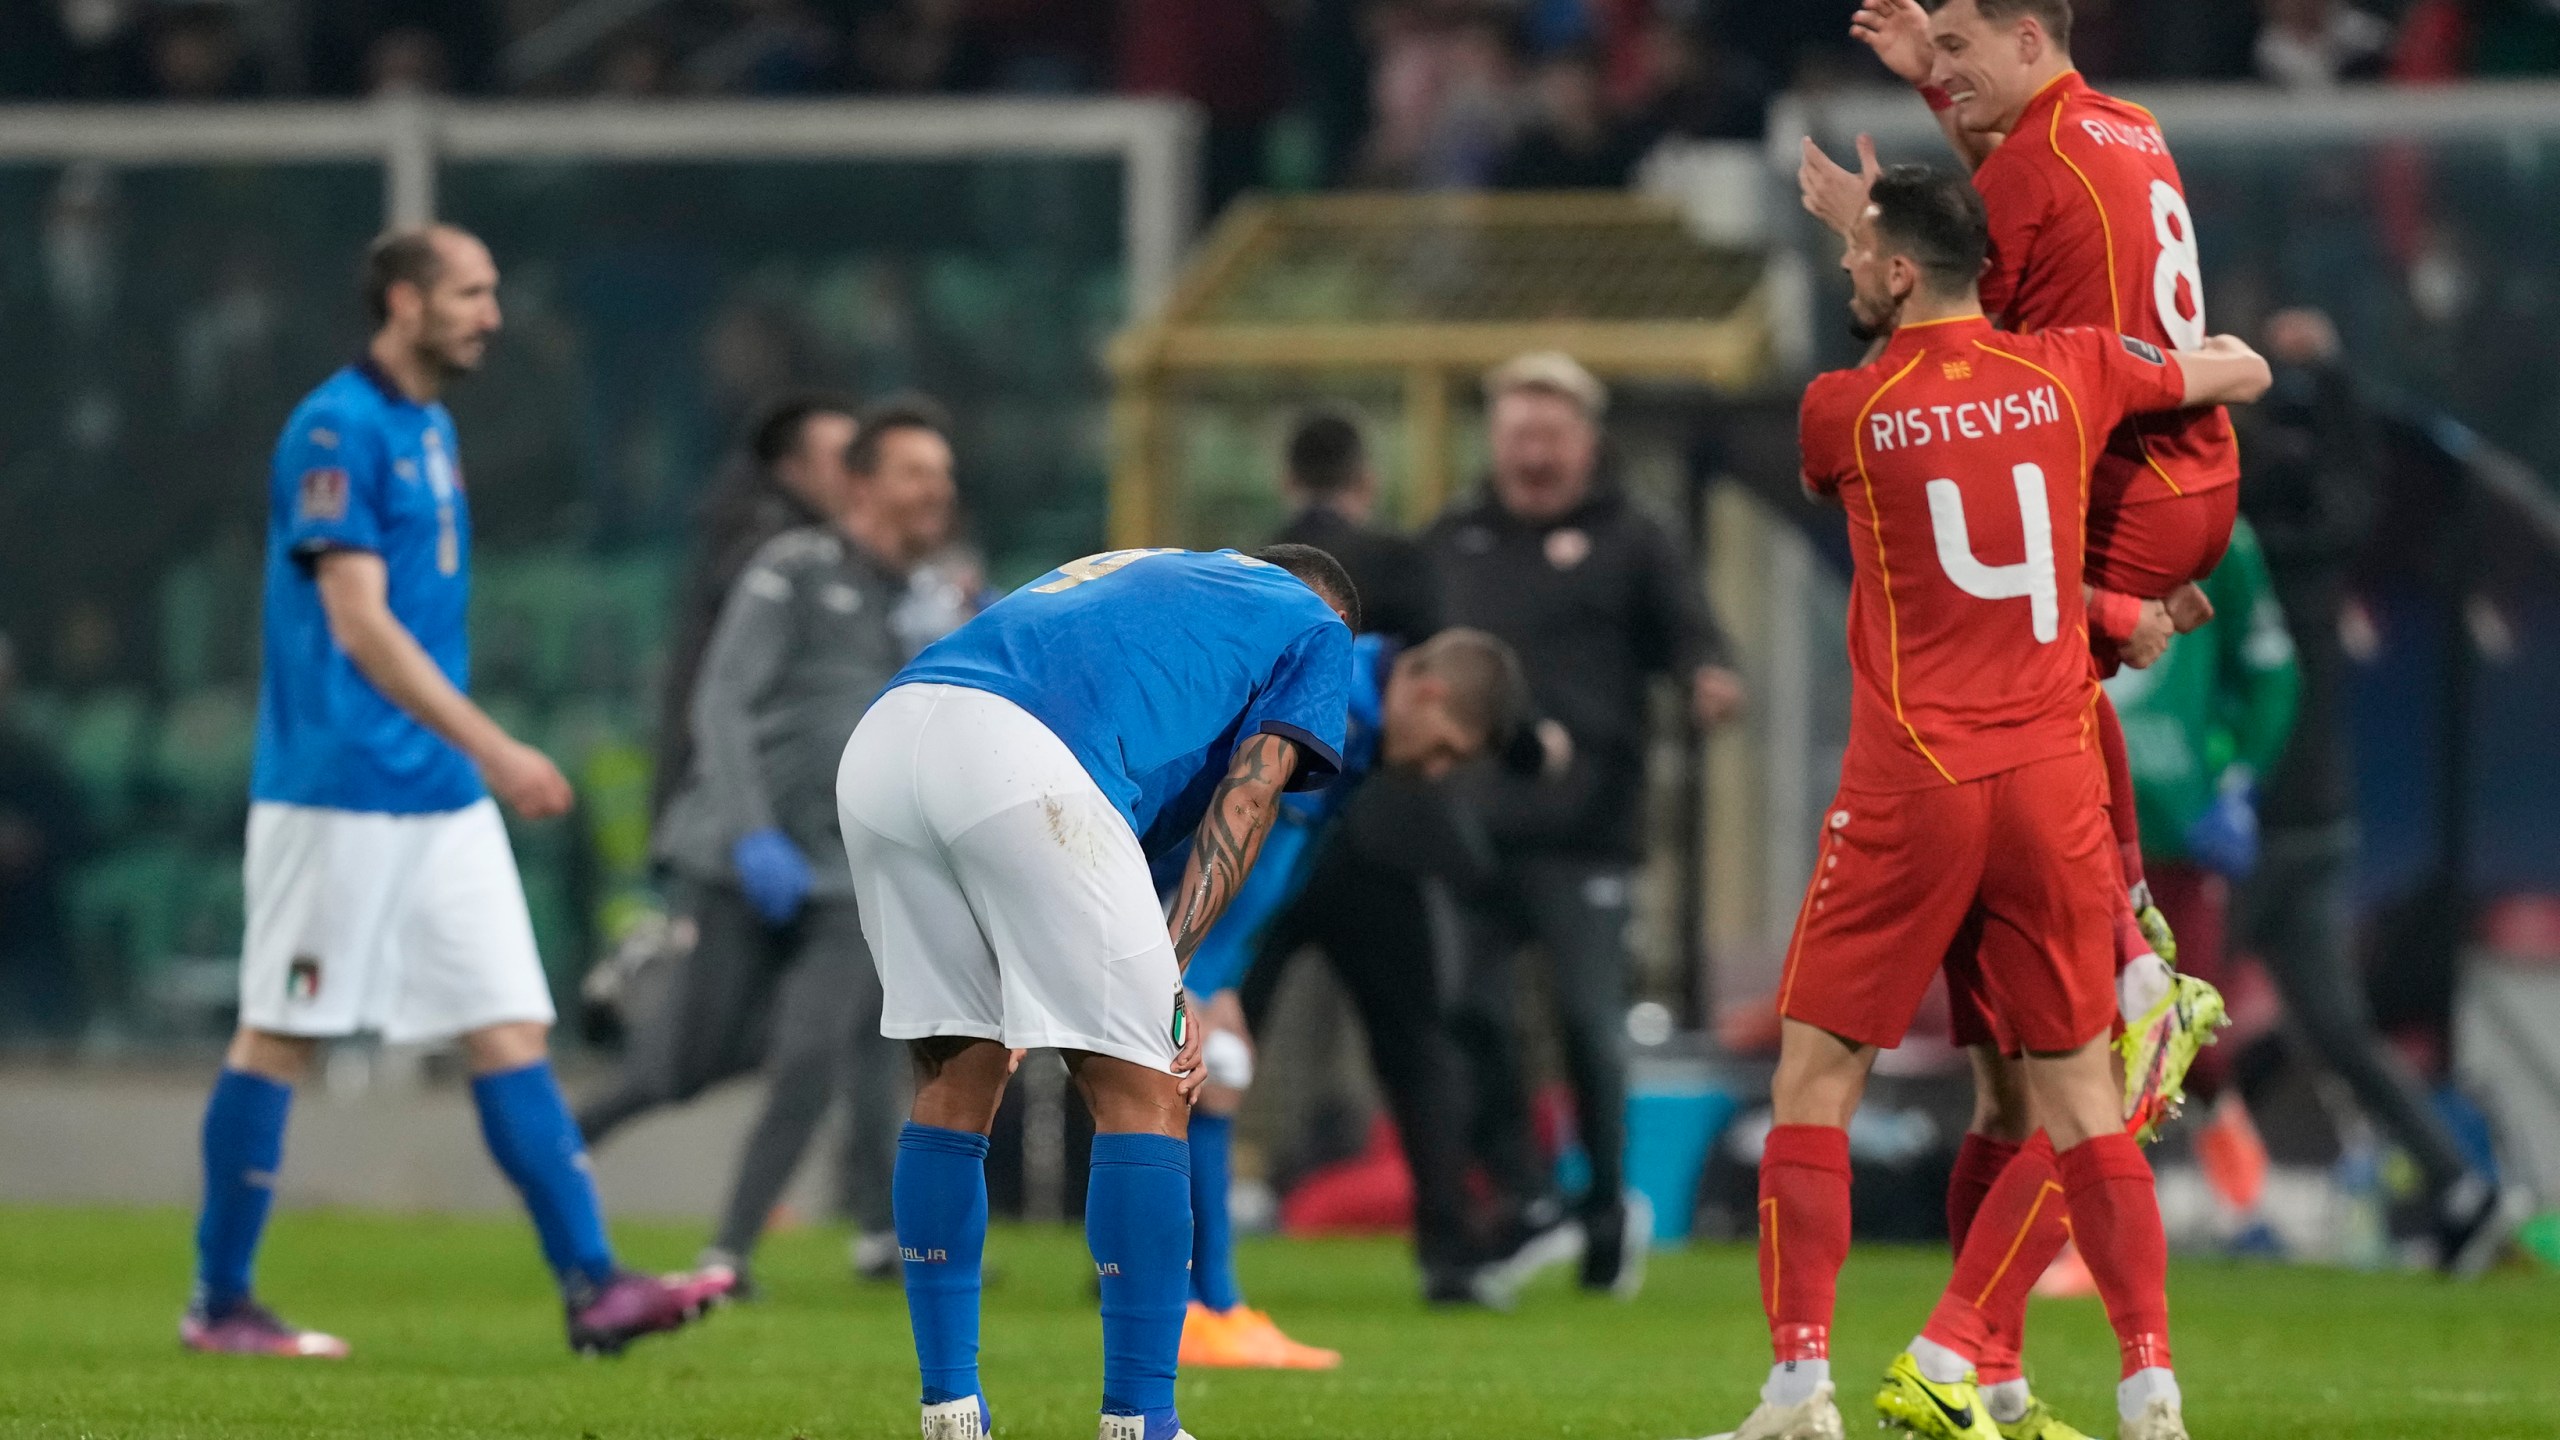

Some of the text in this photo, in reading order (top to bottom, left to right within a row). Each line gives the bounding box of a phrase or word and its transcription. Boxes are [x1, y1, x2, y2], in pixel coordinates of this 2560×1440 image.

[2150, 179, 2206, 350] 8
[1871, 385, 2059, 452] RISTEVSKI
[1926, 462, 2059, 644] 4
